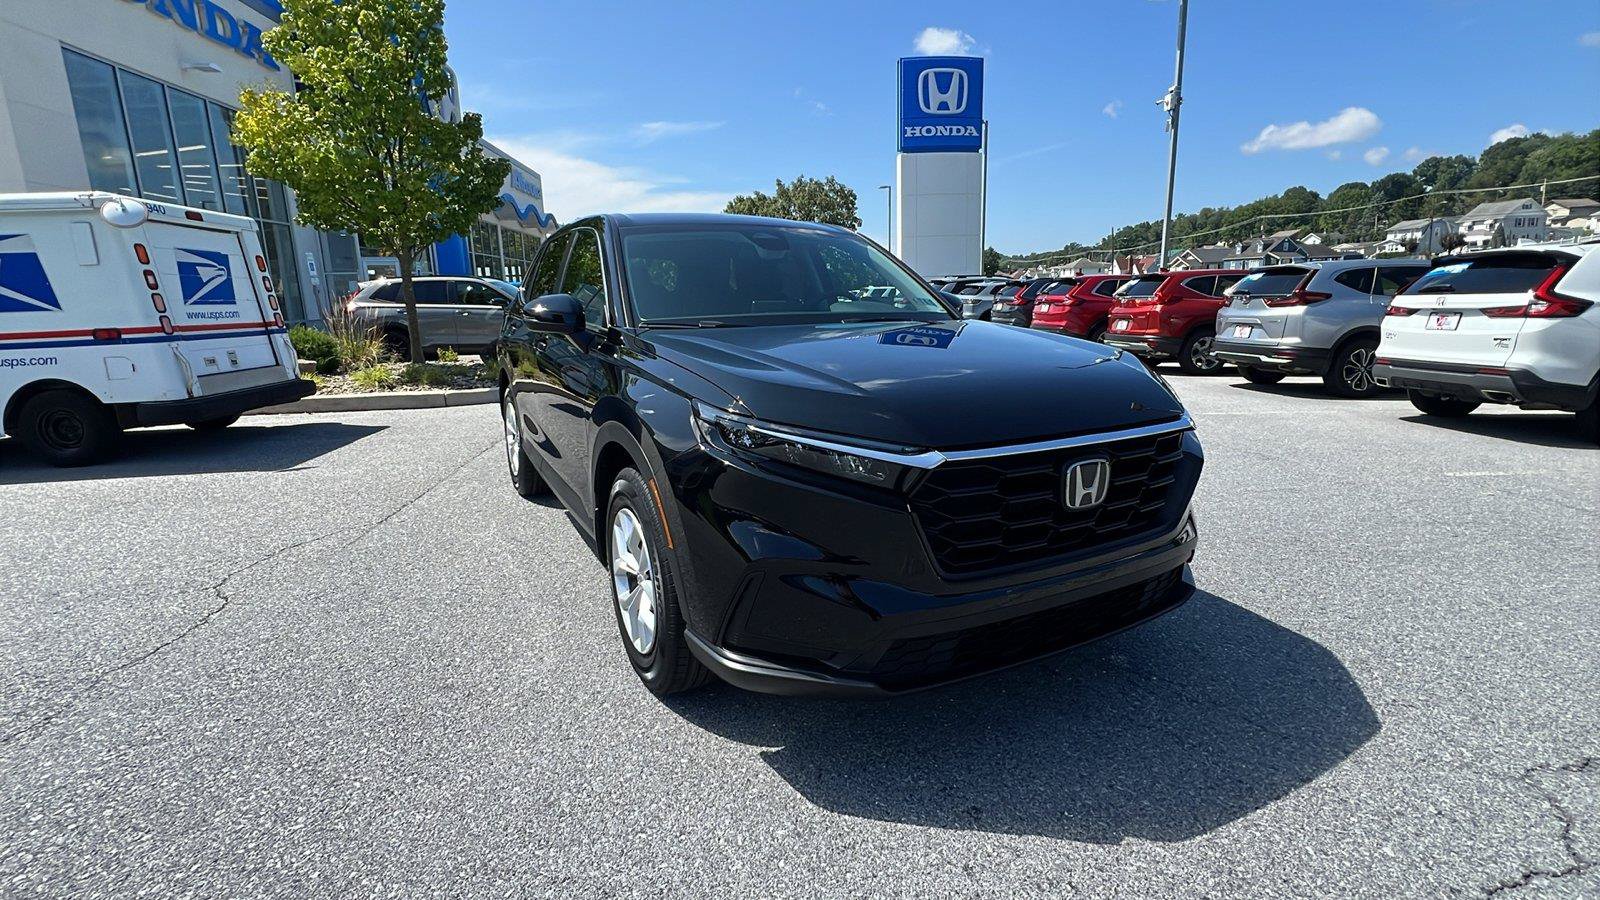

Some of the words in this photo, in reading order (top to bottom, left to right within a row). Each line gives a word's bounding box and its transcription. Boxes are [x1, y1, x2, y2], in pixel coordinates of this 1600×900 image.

[121, 0, 281, 71] NDA
[904, 125, 979, 137] HONDA
[186, 311, 240, 320] www.usps.com
